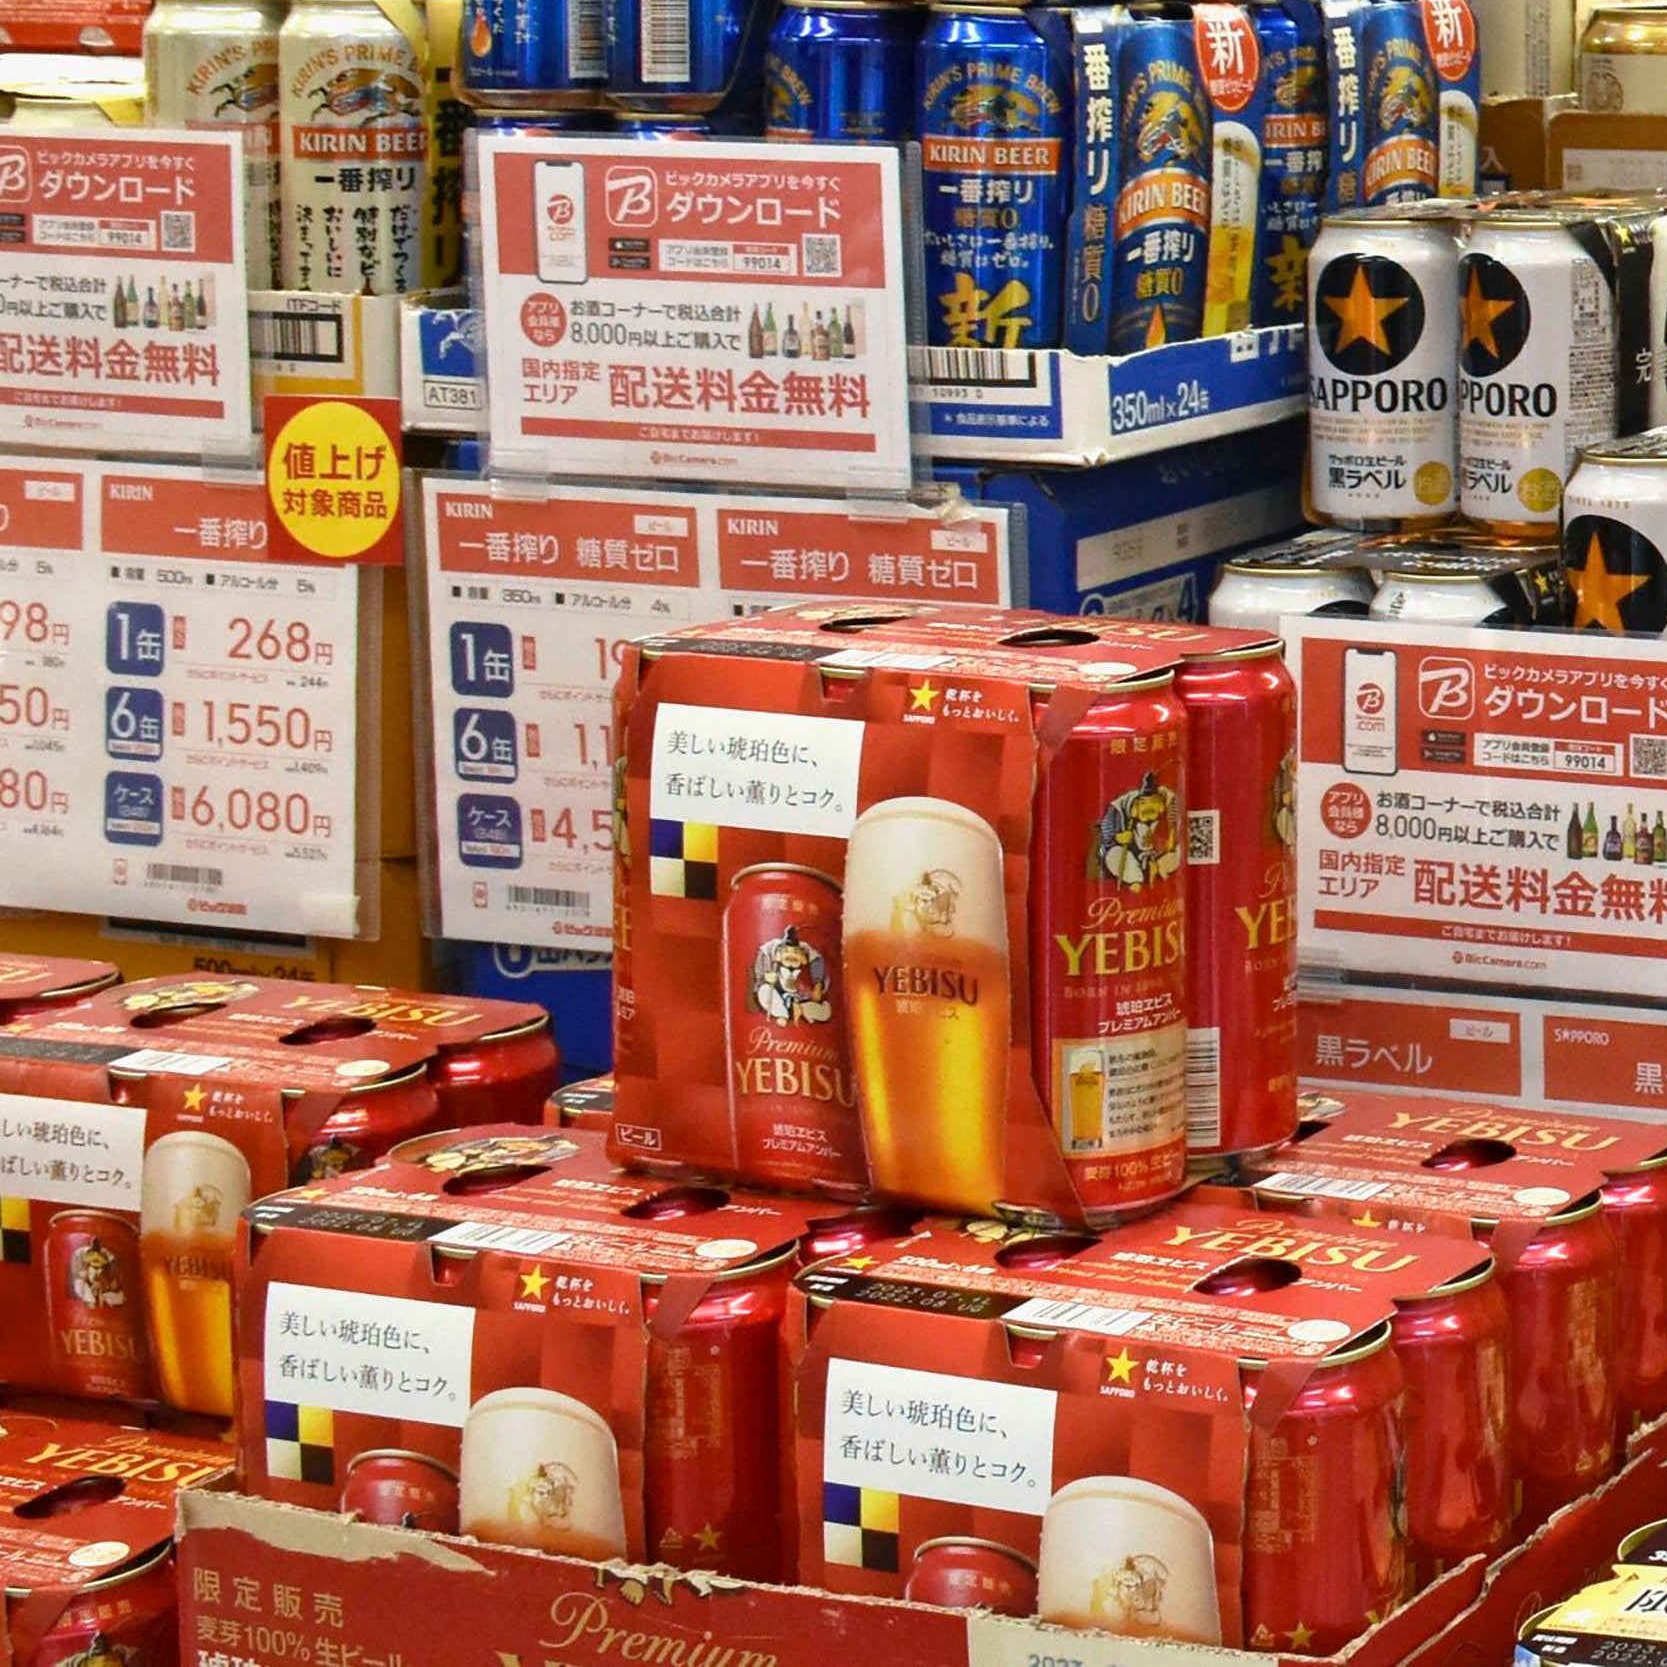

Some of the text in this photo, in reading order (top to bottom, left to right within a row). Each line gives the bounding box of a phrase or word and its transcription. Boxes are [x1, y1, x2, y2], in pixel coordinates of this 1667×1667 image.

[301, 133, 368, 153] KIRIN
[929, 142, 1051, 167] KIRIN BEER
[666, 195, 841, 228] ダウンロード
[570, 300, 741, 323] お酒コーナーで税込合計
[522, 358, 601, 382] 国内指定
[523, 384, 578, 404] エリア
[608, 364, 871, 419] 配送料金無料
[1307, 376, 1450, 414] SAPPORO
[283, 442, 387, 481] 値上げ
[1328, 453, 1407, 467] サッポロ生ビール
[109, 484, 153, 501] KIRIN
[1328, 466, 1407, 491] 黒ラベル
[283, 489, 388, 520] 対象商品
[445, 502, 493, 520] KIRIN
[458, 532, 680, 574] 一番搾り 糖質ゼロ
[741, 549, 977, 589] 一番搾り 糖質ゼロ
[114, 612, 333, 667] 1缶 268円
[459, 633, 511, 683] 1缶
[110, 691, 334, 754] 6缶 1,550円
[460, 716, 513, 762] 6缶
[666, 728, 819, 769] 美しい琥珀色に、
[1564, 752, 1606, 769] 99014
[665, 771, 844, 814] 香ばしい薫りとコク。
[1376, 791, 1561, 822] お酒コーナーで税込合計
[113, 784, 332, 839] ケース 6,080円
[467, 805, 512, 827] ケース
[1375, 814, 1560, 851] 8,000円以上ご購入で
[1318, 849, 1406, 877] 国内指定
[1318, 877, 1380, 900] エリア
[1465, 950, 1547, 971] BicCamera.com
[1315, 1035, 1433, 1078] 黒ラベル
[279, 1312, 432, 1357] 美しい琥珀色に、
[278, 1354, 458, 1403] 香ばしい薫りとコク。
[1145, 1358, 1187, 1378] 乾杯を
[1142, 1377, 1230, 1403] もっとおいしく。
[842, 1389, 1008, 1439] 美しい琥珀色に、
[840, 1434, 1038, 1491] 香ばしい薫りとコク。
[194, 1567, 345, 1629] 限定販売
